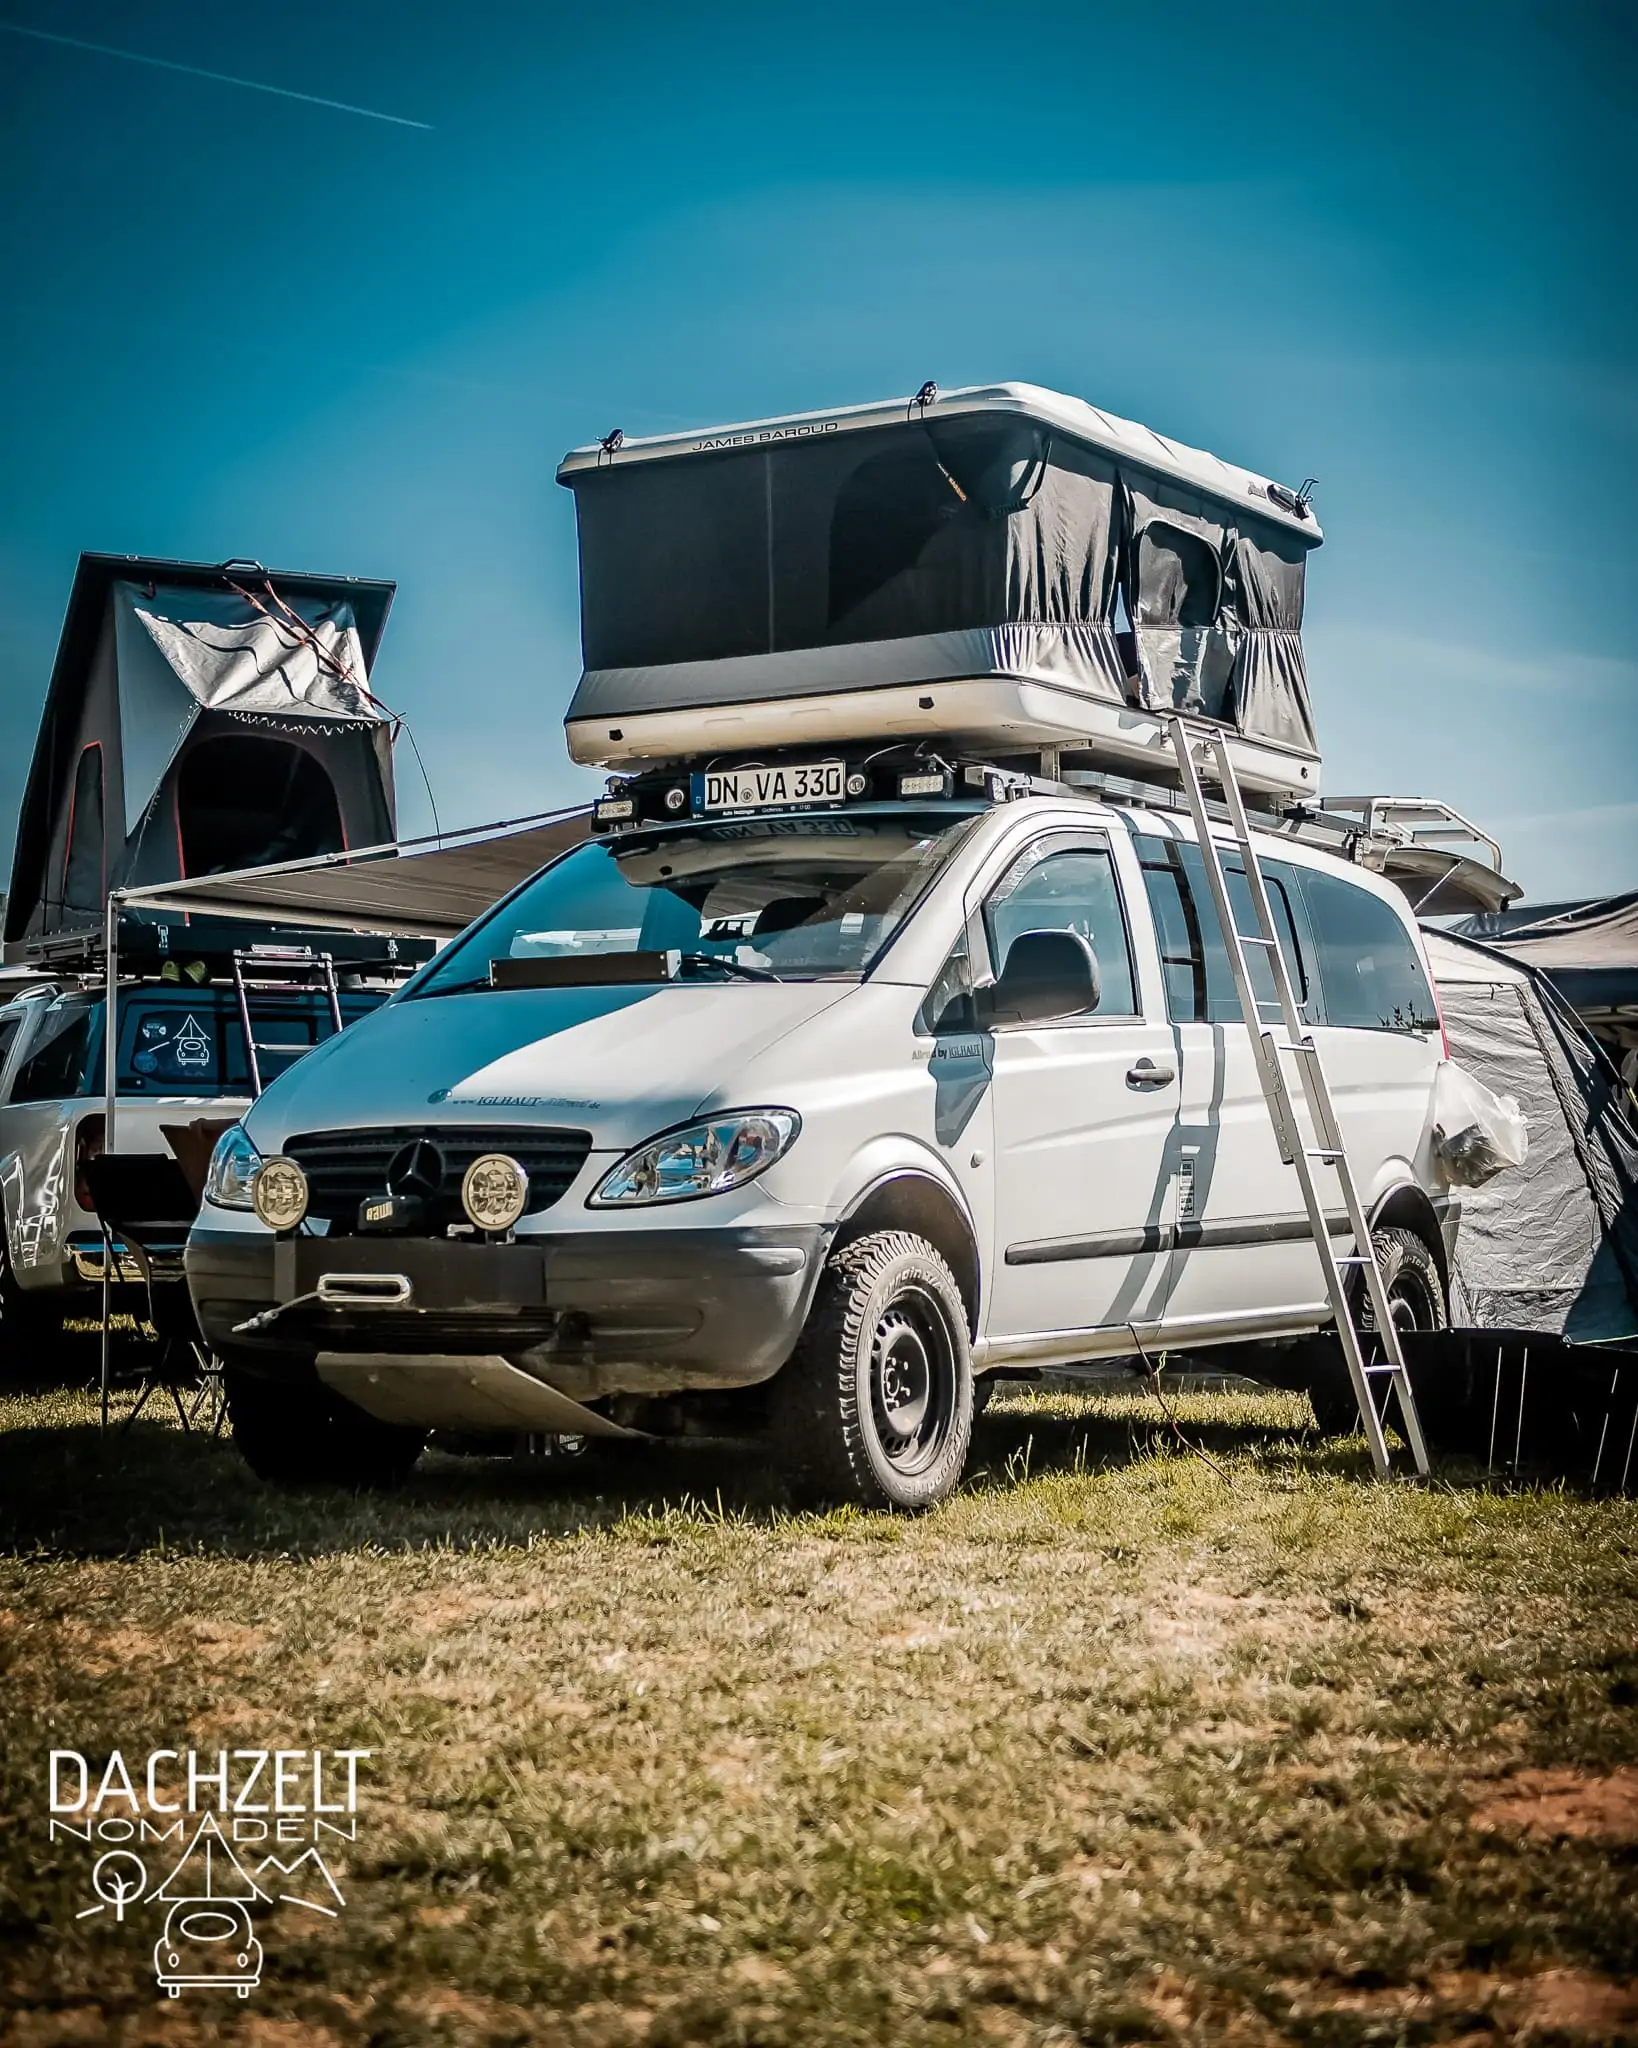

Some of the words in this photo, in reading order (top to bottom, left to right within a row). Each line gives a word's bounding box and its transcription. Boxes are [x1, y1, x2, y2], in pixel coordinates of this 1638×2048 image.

[692, 435, 754, 451] JAMES
[759, 422, 838, 442] BAROUD
[707, 776, 738, 805] DN
[756, 772, 787, 800] VA
[795, 767, 841, 798] 330
[937, 1047, 947, 1060] by
